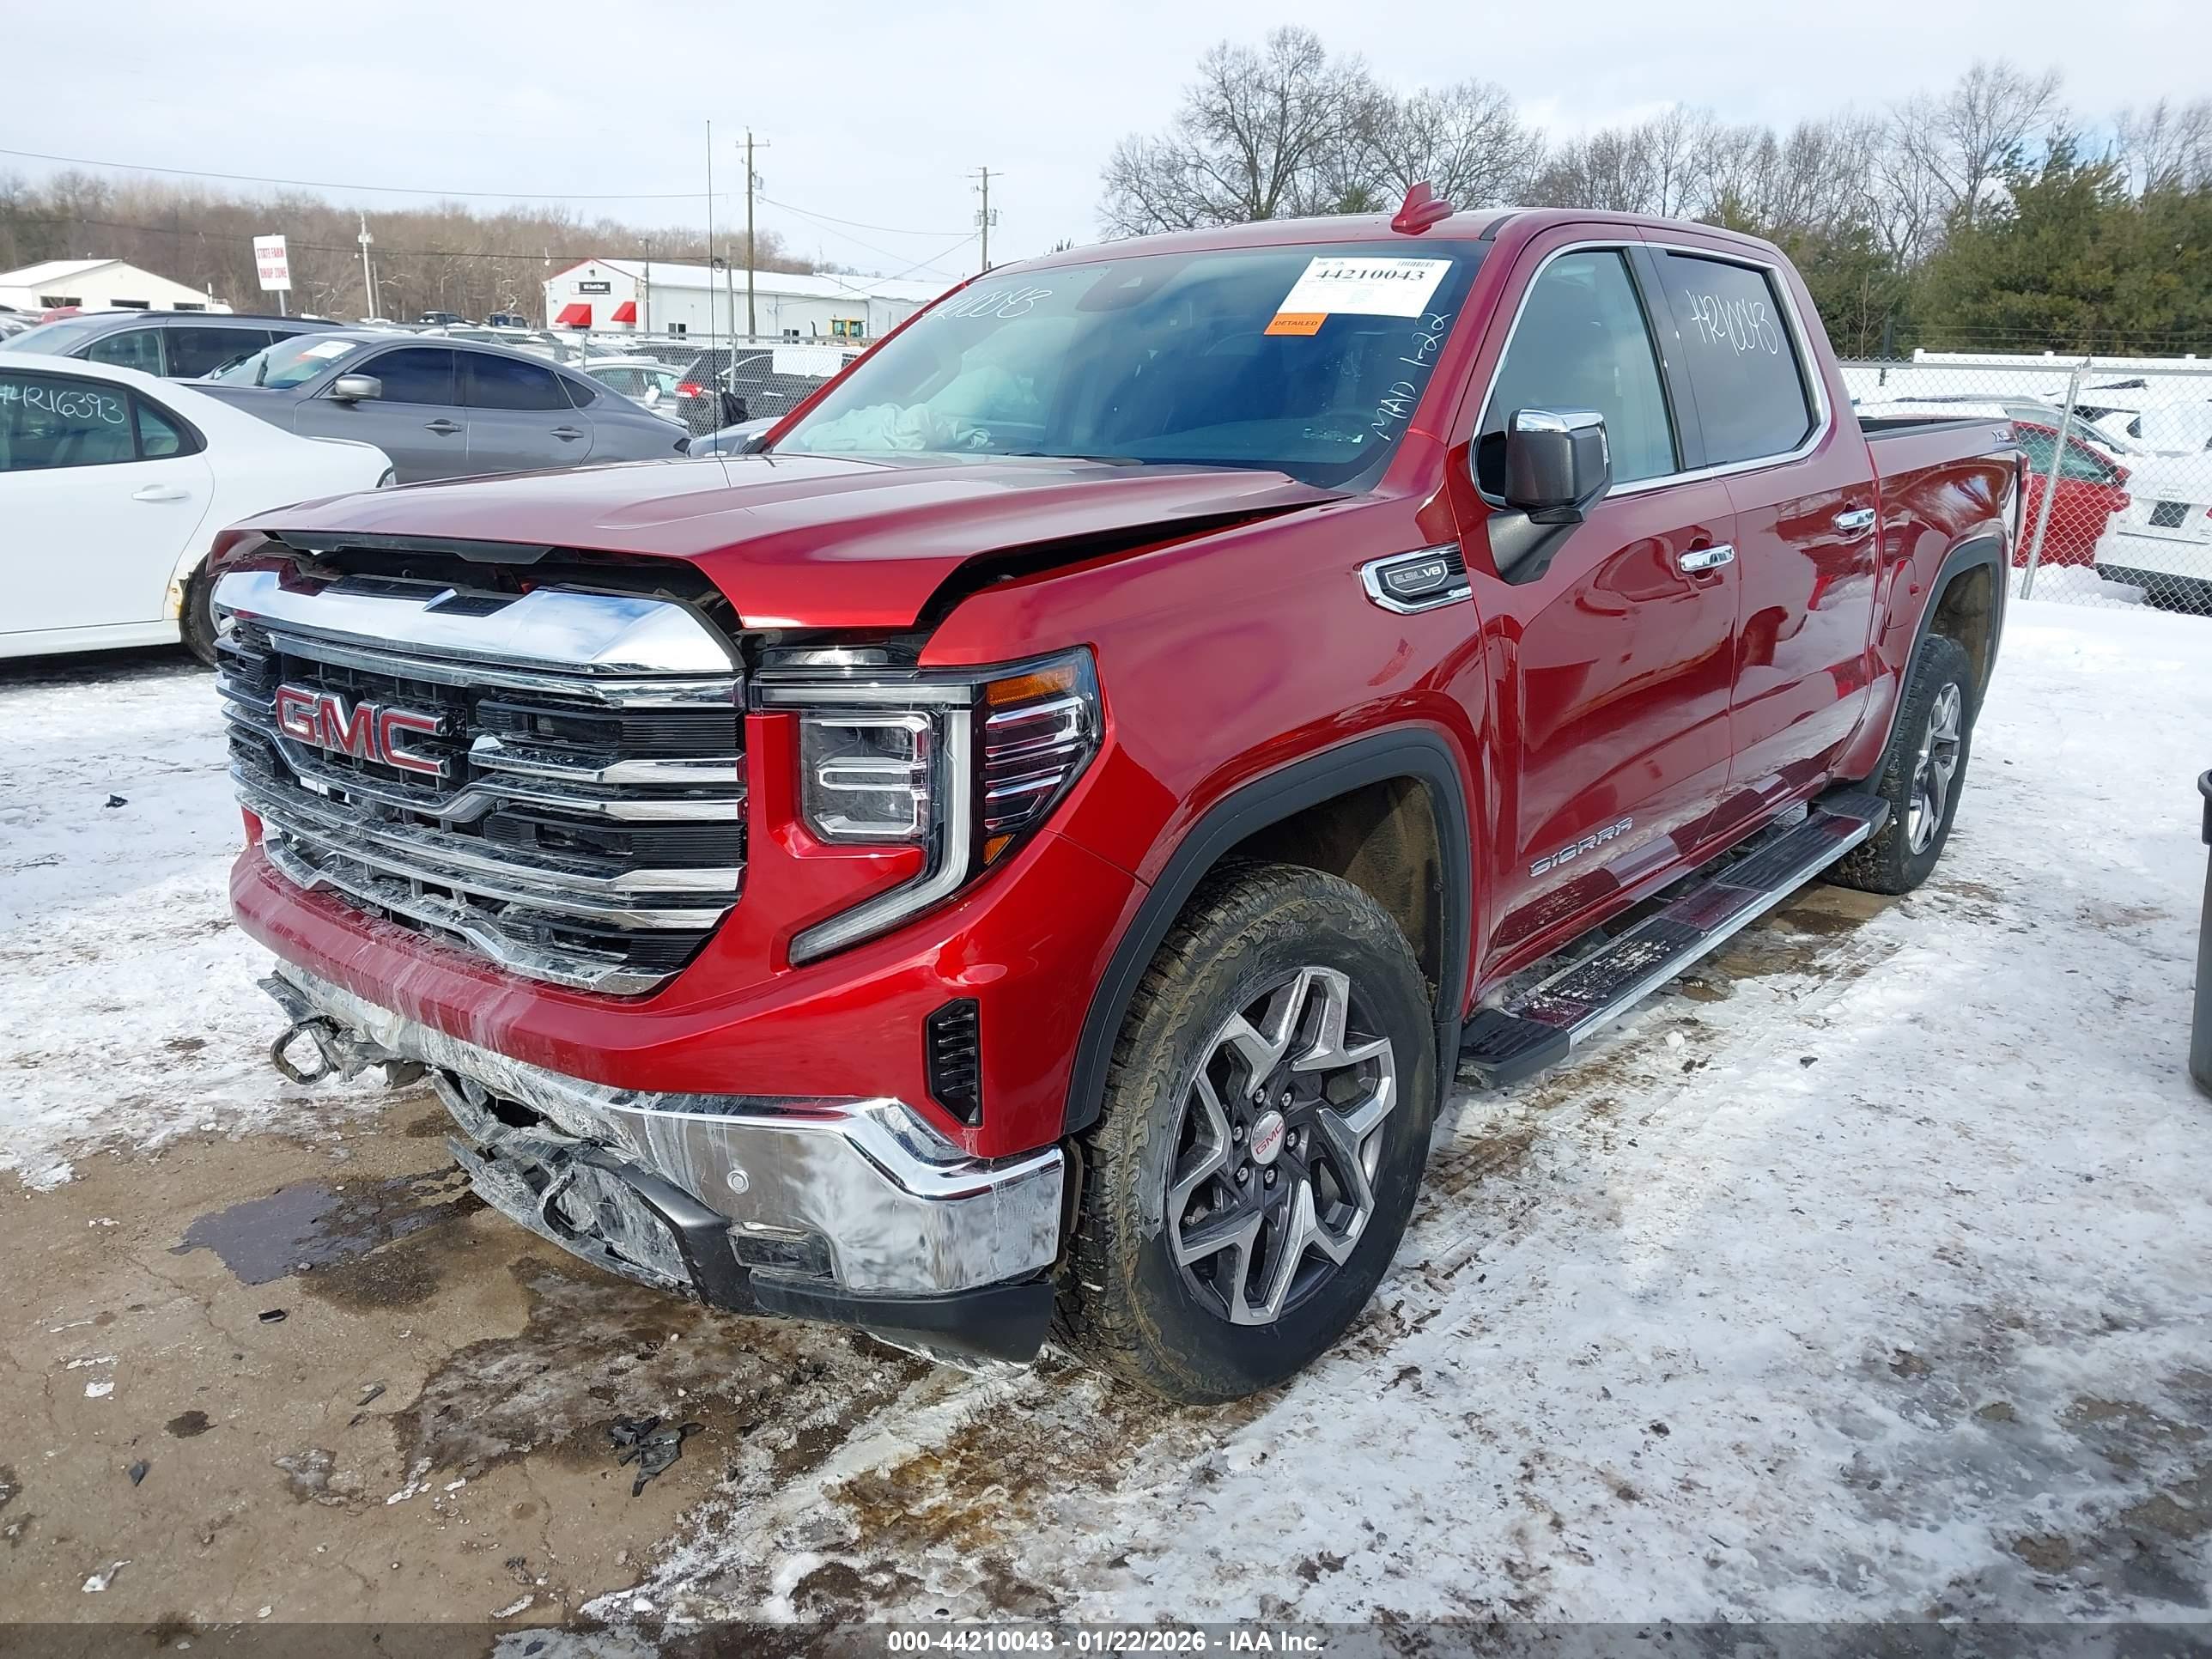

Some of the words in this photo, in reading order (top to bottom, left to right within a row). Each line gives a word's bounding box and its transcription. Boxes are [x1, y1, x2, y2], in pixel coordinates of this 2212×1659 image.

[1316, 269, 1426, 282] 44210043
[1422, 566, 1442, 577] V8
[276, 684, 449, 778] GMC
[1528, 817, 1633, 878] SIERRA
[1256, 1120, 1284, 1155] GMC
